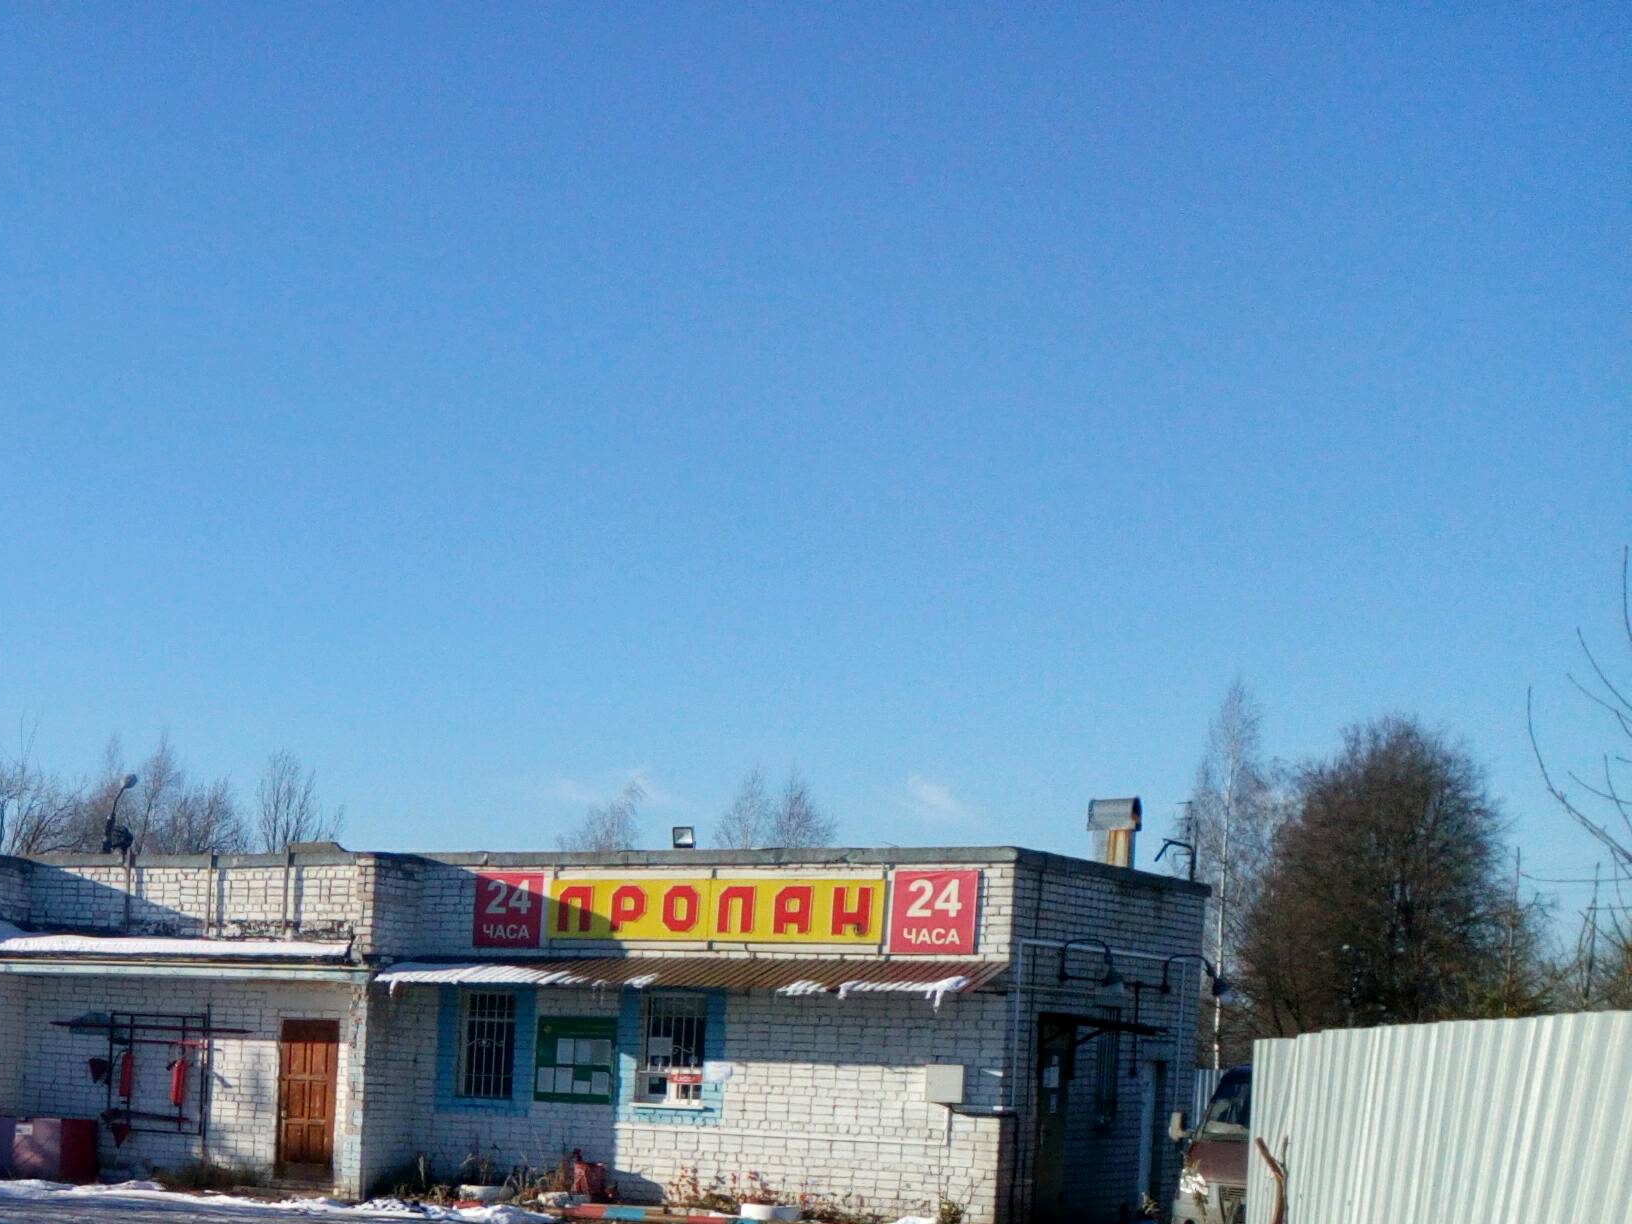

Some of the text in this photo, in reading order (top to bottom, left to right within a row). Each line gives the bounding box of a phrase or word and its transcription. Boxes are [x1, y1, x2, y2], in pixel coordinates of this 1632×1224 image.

[485, 879, 532, 914] 24
[557, 884, 873, 936] ПРОПАН
[905, 878, 963, 918] 24
[482, 923, 530, 939] ЧАСА
[902, 927, 961, 945] ЧАСА
